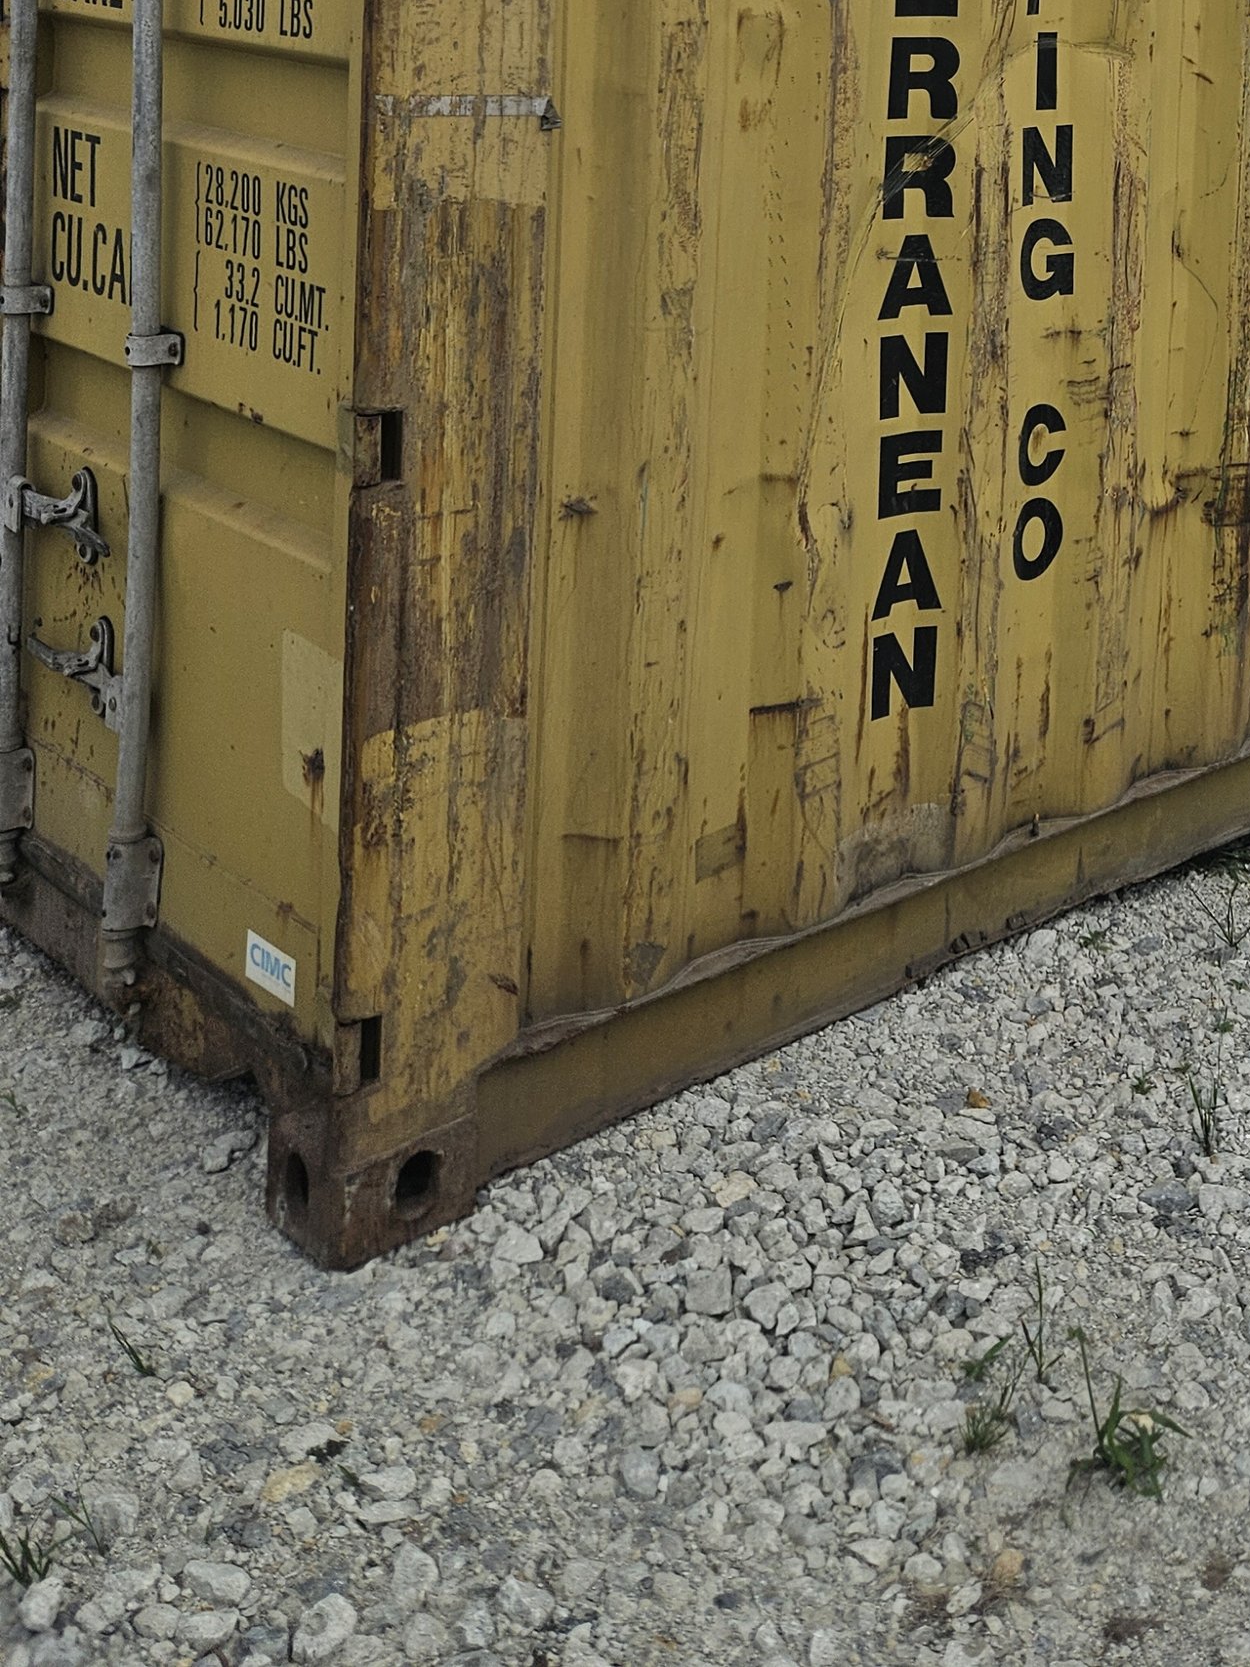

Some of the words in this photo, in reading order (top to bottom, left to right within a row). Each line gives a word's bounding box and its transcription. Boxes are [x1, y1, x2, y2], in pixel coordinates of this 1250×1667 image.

[53, 126, 101, 208] NET
[205, 164, 261, 217] 28,200
[275, 181, 309, 230] KGS
[51, 211, 132, 307] CU.CA
[225, 259, 260, 308] 33.2
[274, 274, 330, 331] CU.MT.
[204, 207, 261, 260] 62,170
[275, 225, 309, 274] LBS
[214, 299, 258, 351] 1,170
[272, 318, 321, 375] CU.FT.
[1013, 402, 1066, 582] CO
[250, 943, 292, 988] CIMC
